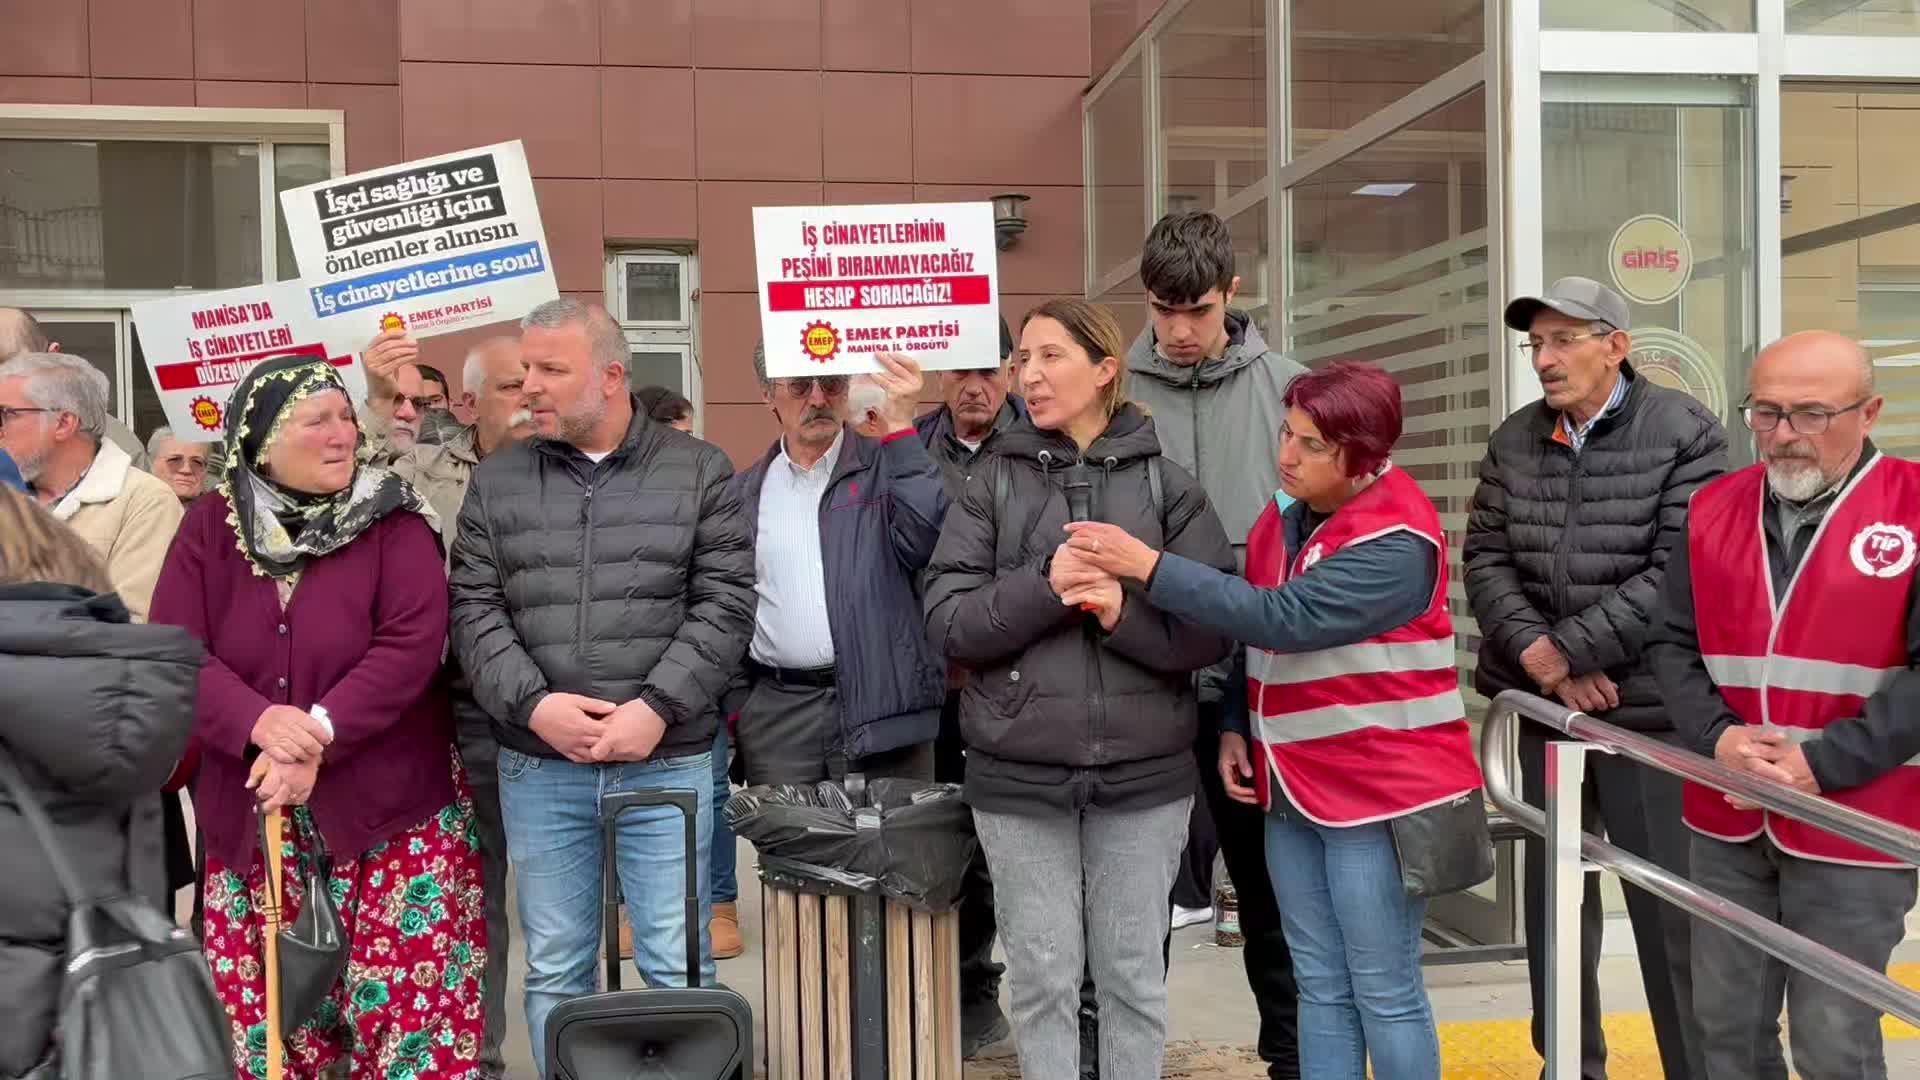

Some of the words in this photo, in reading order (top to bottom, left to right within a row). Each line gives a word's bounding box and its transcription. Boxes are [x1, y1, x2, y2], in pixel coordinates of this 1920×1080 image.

[325, 189, 369, 214] İşçi
[371, 172, 451, 203] sağlığı
[452, 166, 484, 184] ve
[331, 201, 442, 247] güvenliği
[446, 193, 494, 221] için
[802, 221, 817, 249] İŞ
[824, 219, 945, 245] CİNAYETLERİNİN
[326, 236, 429, 275] önlemler
[434, 221, 518, 251] alınsın
[1622, 246, 1680, 272] GİRİŞ
[314, 287, 337, 313] İş
[338, 260, 488, 307] cinayetlerine
[491, 247, 539, 271] son!
[782, 250, 832, 281] PEŞİNİ
[838, 248, 974, 277] BIRAKMAYACAĞIZ
[409, 307, 443, 322] EMEK
[445, 296, 492, 316] PARTİSİ
[804, 287, 855, 308] HESAP
[861, 279, 952, 306] SORACAĞIZ!
[205, 323, 293, 356] CİNAYETLERİ
[809, 336, 833, 346] EMEP
[846, 327, 892, 341] EMEK
[896, 320, 960, 338] PARTİSİ
